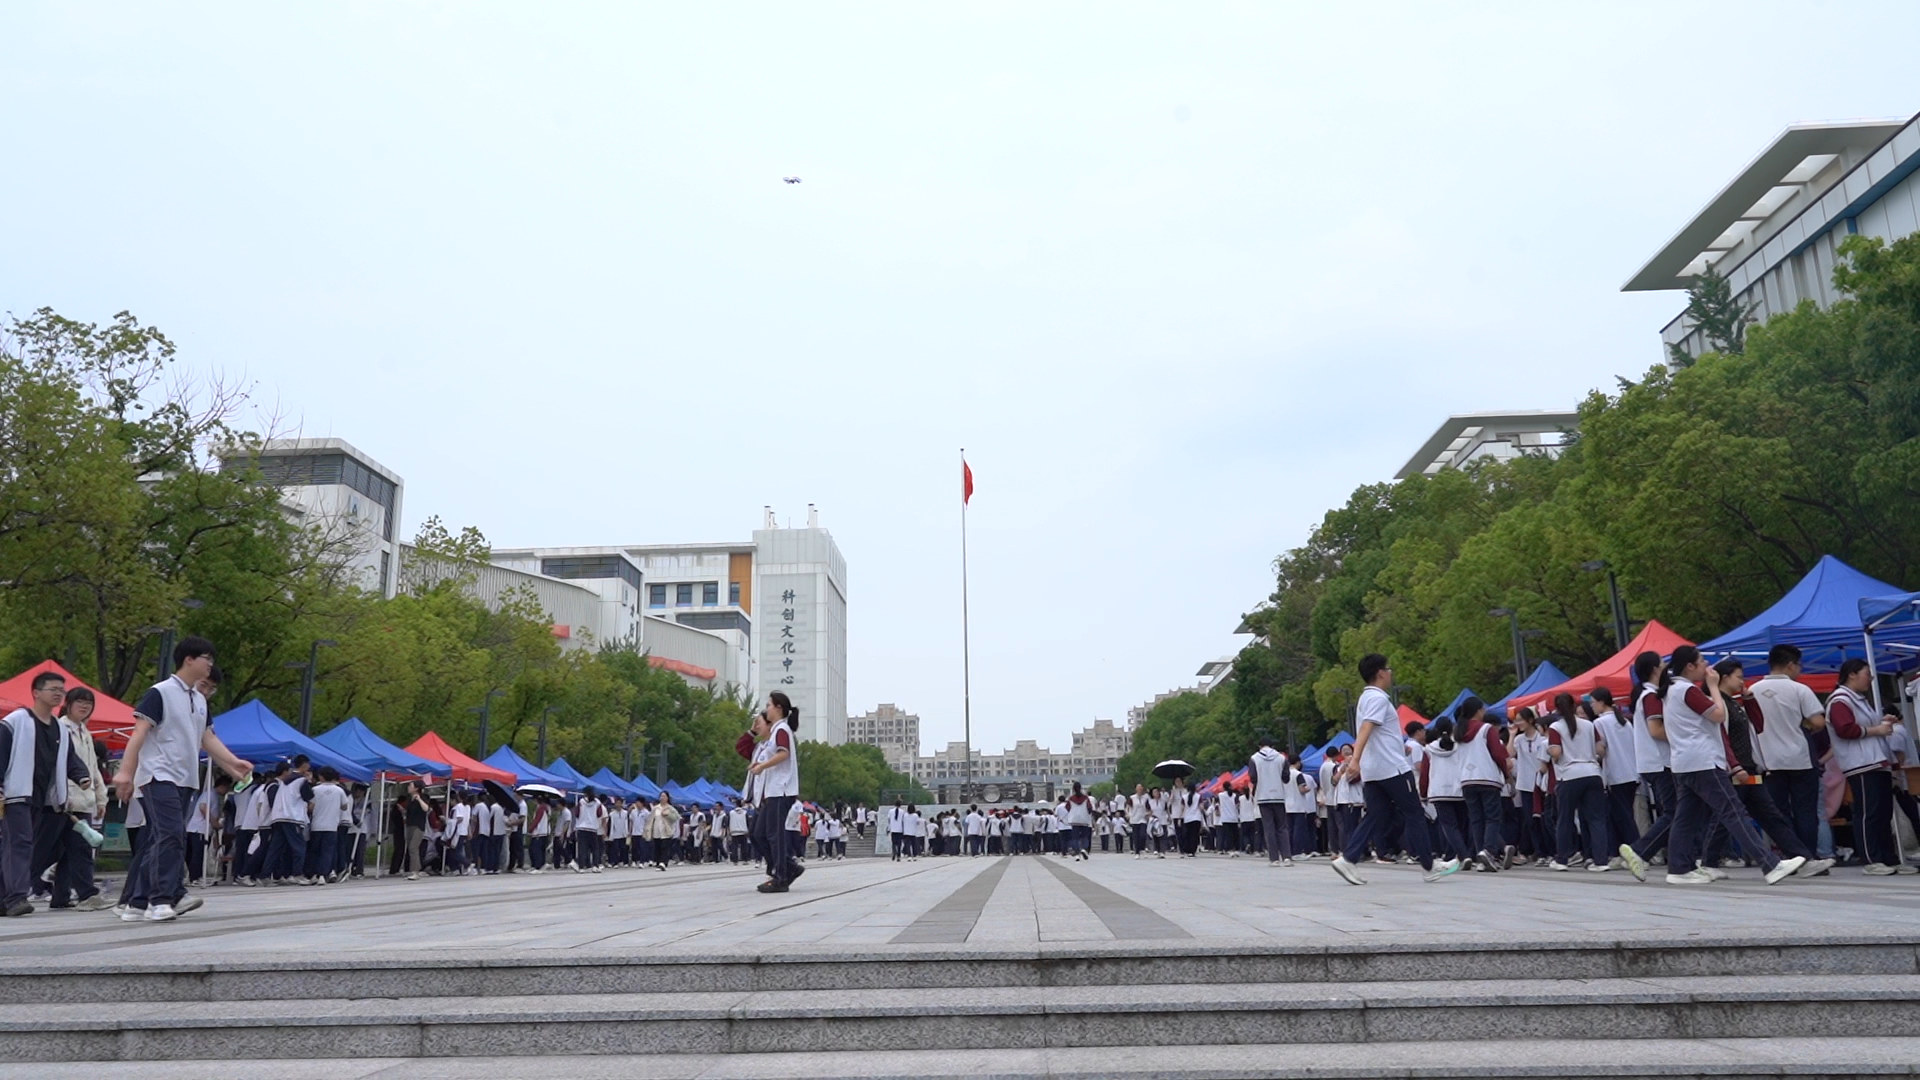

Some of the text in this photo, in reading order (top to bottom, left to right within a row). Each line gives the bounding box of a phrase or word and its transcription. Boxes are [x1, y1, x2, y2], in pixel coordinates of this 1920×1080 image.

[780, 588, 796, 685] 科创文化中心
